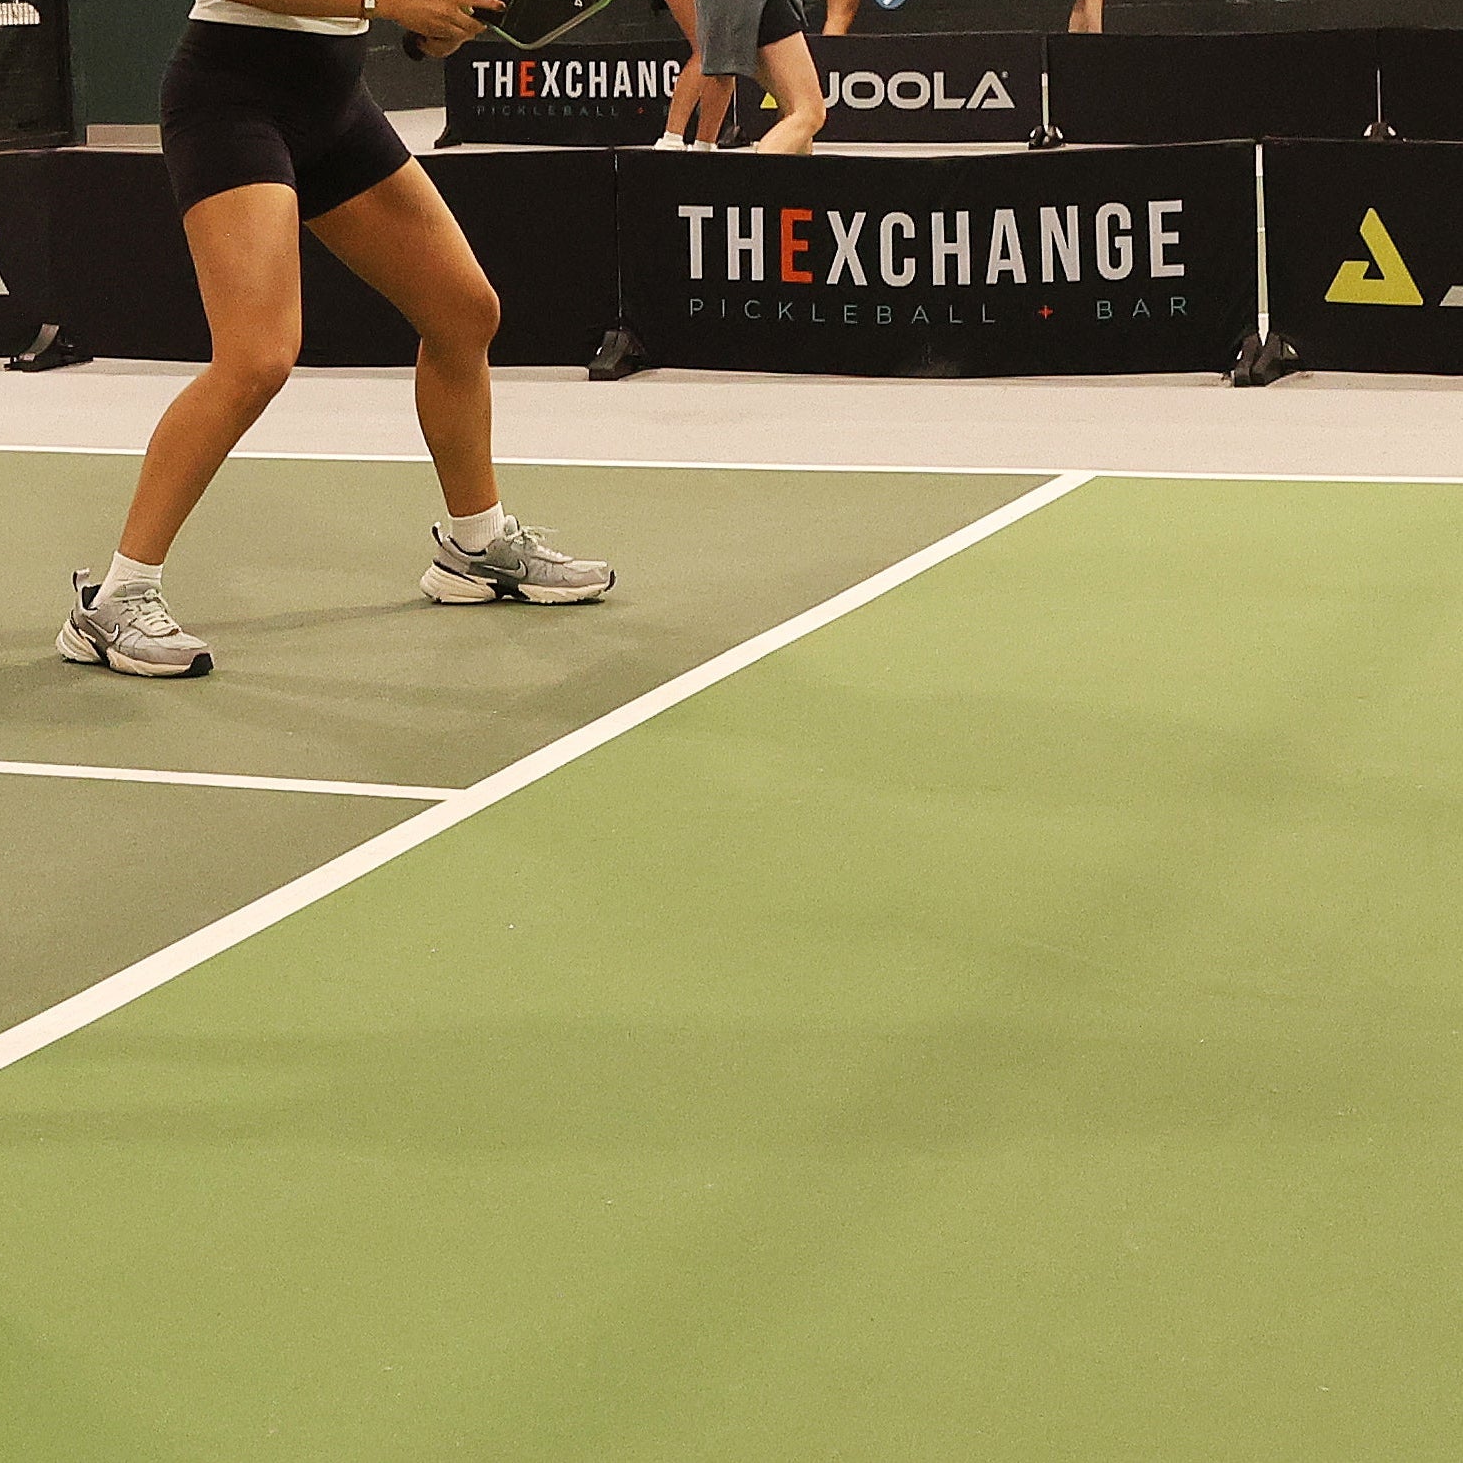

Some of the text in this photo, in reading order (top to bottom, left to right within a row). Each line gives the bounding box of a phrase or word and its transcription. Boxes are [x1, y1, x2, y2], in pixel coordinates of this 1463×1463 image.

[471, 59, 681, 99] THEXCHANG
[677, 198, 1186, 289] THEXCHANGE
[688, 297, 998, 327] PICKLEBALL
[1096, 295, 1191, 321] BAR
